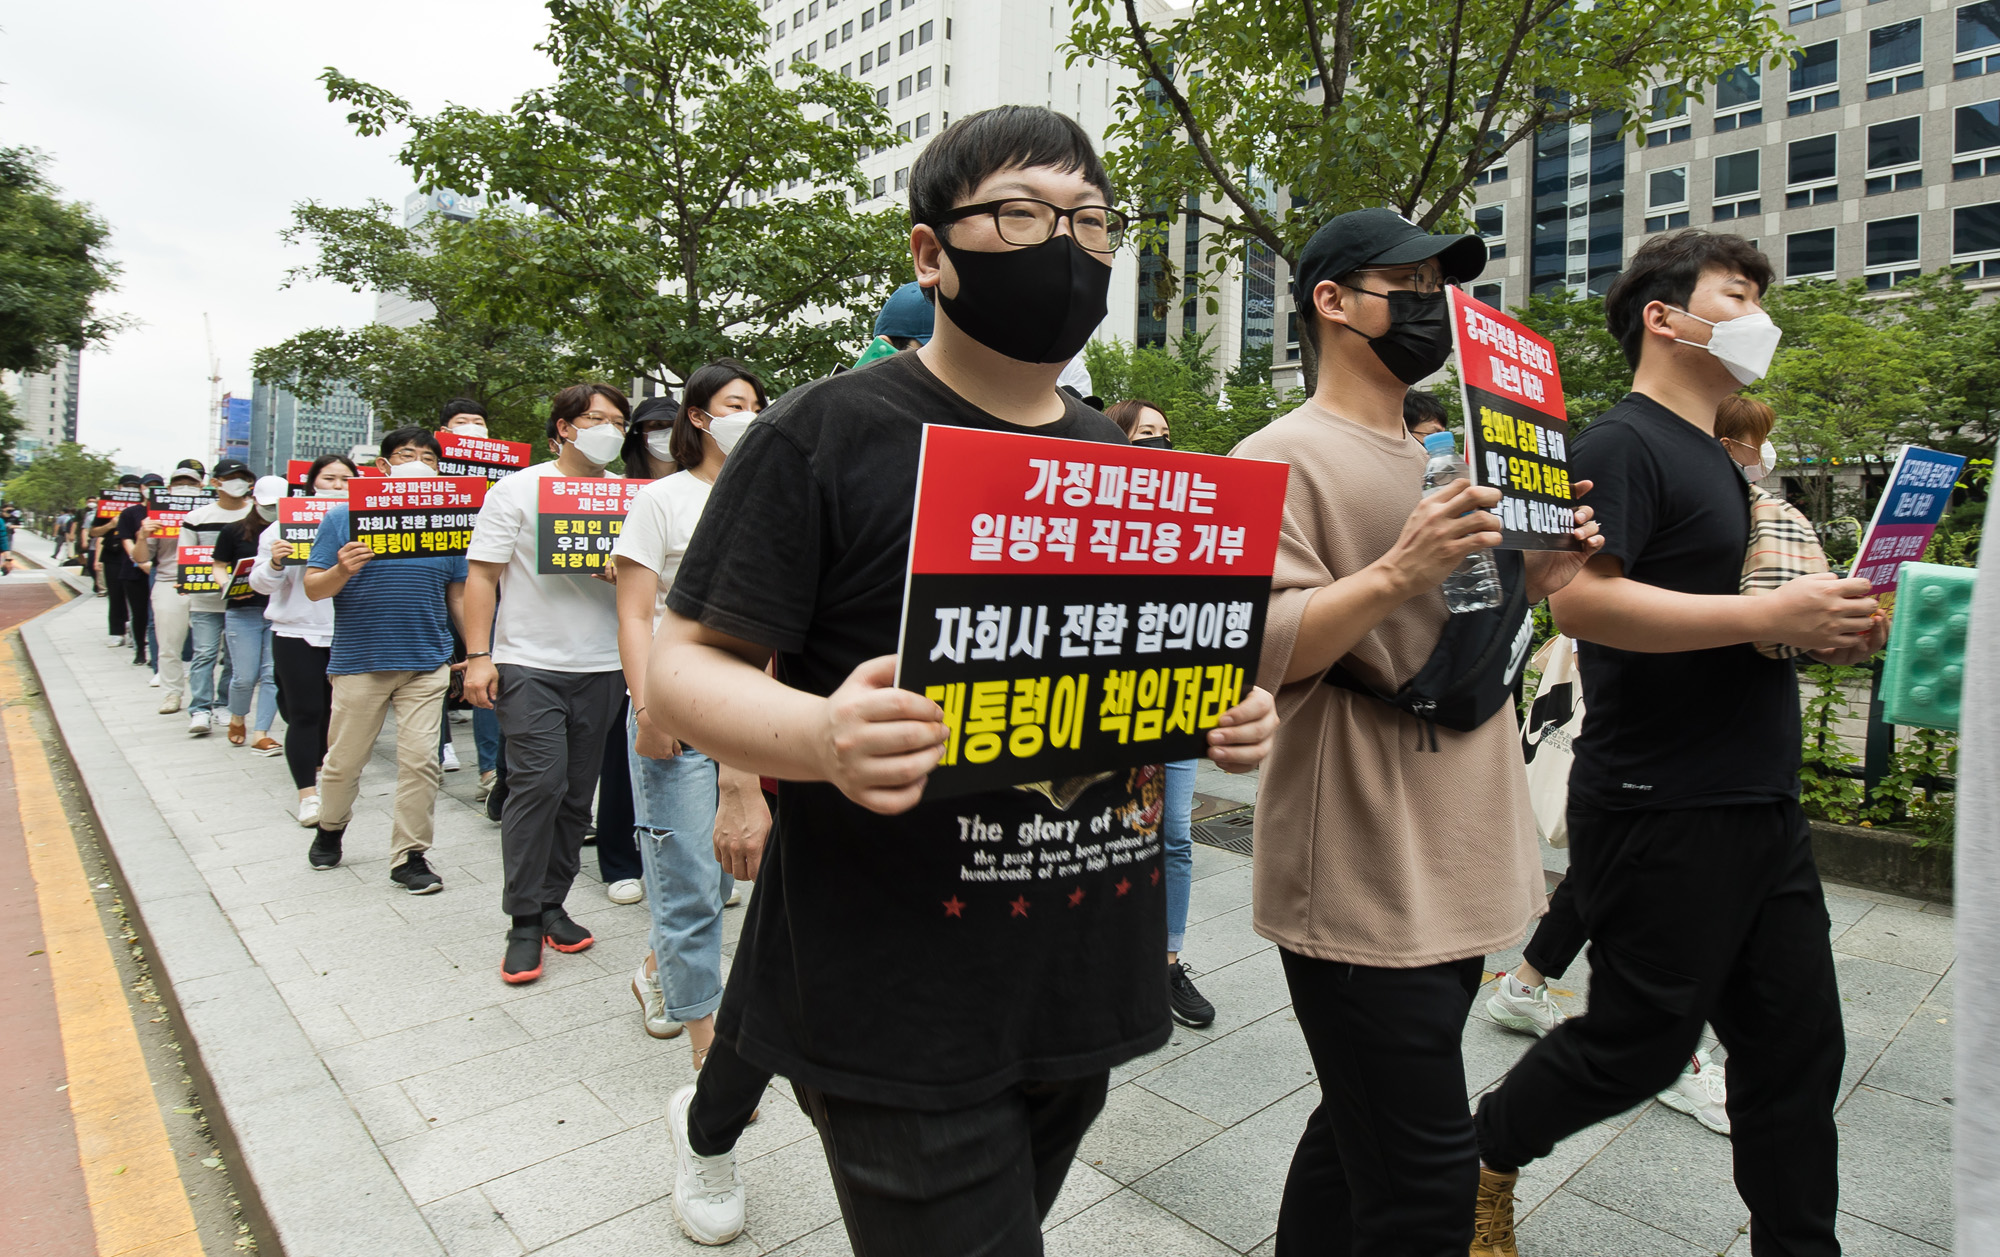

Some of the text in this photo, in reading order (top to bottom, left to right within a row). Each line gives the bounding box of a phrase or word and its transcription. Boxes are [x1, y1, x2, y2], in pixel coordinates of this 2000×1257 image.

[1463, 305, 1554, 376] 정규직전환 중단하고
[1489, 355, 1545, 404] 재논의 하라!
[1480, 405, 1567, 463] 청와대 성과를 위해
[445, 446, 519, 464] 일방적 직고용 거부
[457, 438, 510, 453] 가정파탄내는
[438, 462, 466, 475] 자회사
[467, 465, 487, 476] 전환
[1509, 457, 1542, 494] 우리가
[1542, 465, 1572, 500] 희생을
[381, 481, 456, 494] 가정파탄내는
[552, 481, 622, 497] 정규직전환
[1024, 458, 1218, 514] 가정파탄내는
[365, 494, 472, 508] 일방적 직고용 거부
[578, 497, 618, 511] 재논의
[357, 516, 398, 531] 자회사
[401, 515, 427, 530] 전환
[1528, 499, 1576, 535] 하나요???
[554, 520, 602, 535] 문재인
[557, 537, 589, 551] 우리
[969, 514, 1246, 565] 일방적 직고용 거부
[930, 601, 1253, 663] 자회사 전환 합의이행
[1099, 664, 1245, 745] 책임져라!
[957, 814, 1003, 842] The
[1018, 813, 1080, 847] glory
[1090, 806, 1113, 834] of
[973, 849, 997, 866] the
[1002, 850, 1034, 868] past
[1039, 848, 1071, 864] have
[1037, 863, 1054, 880] of
